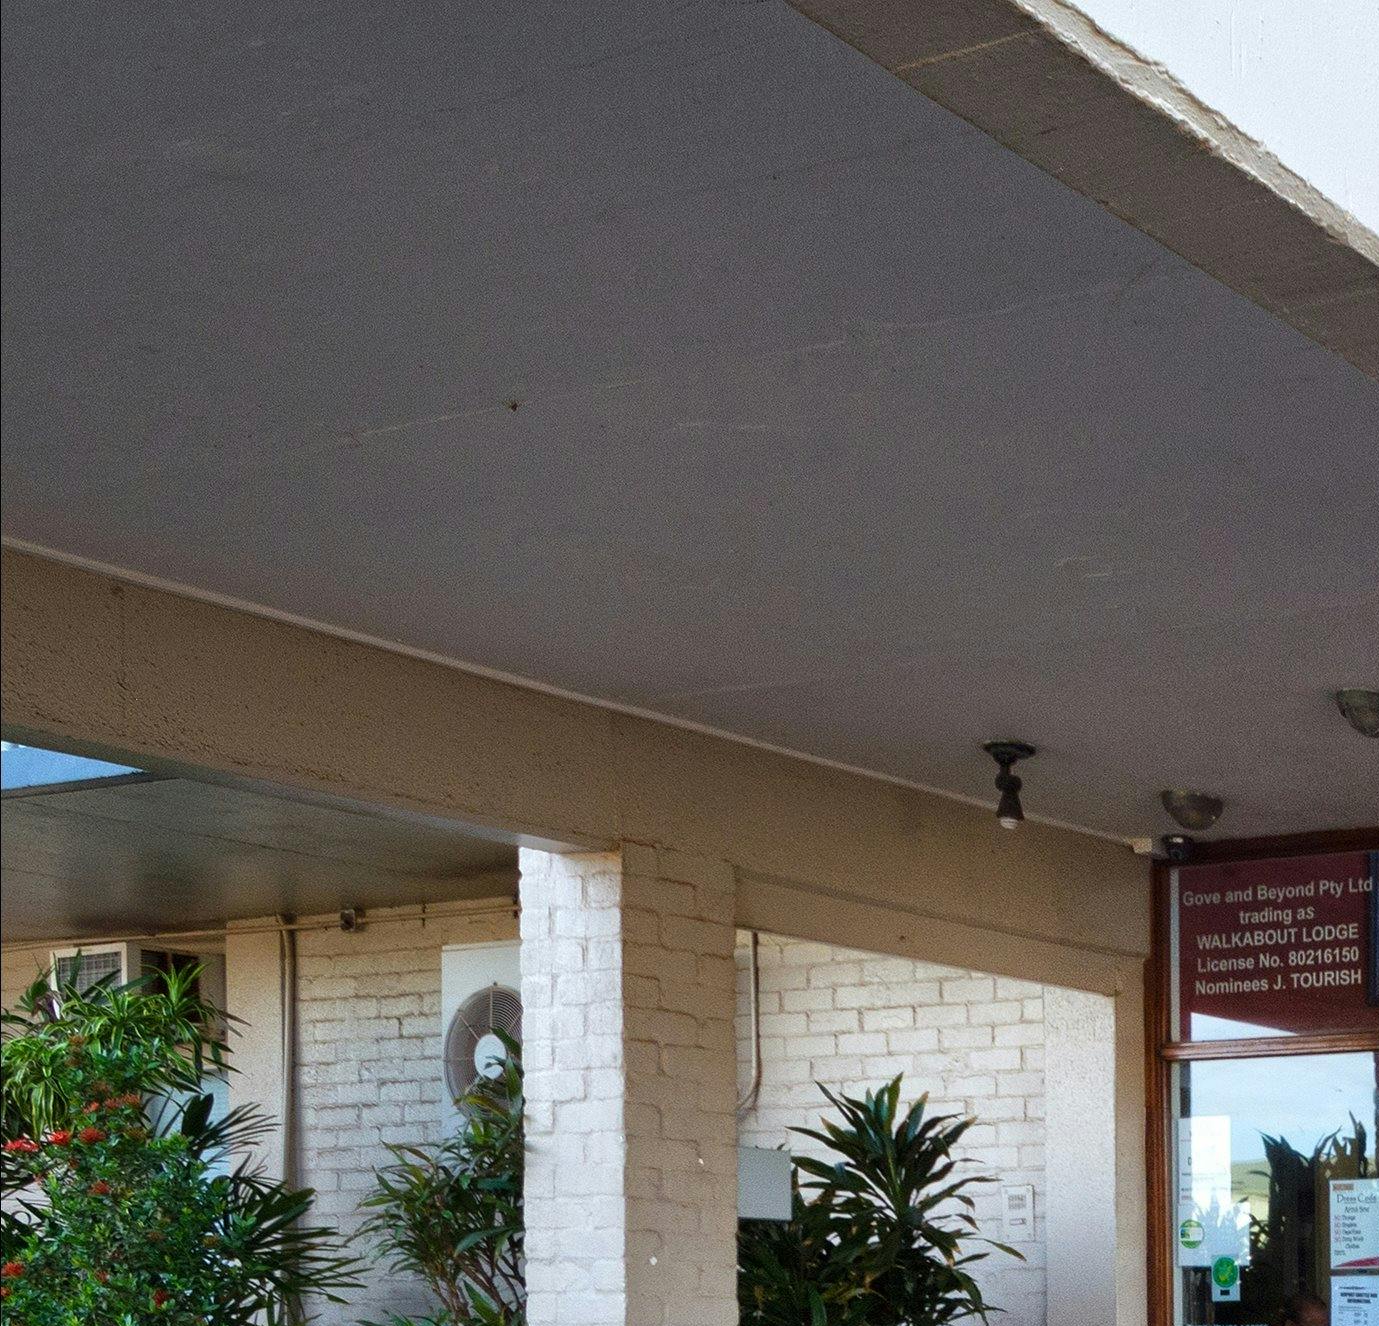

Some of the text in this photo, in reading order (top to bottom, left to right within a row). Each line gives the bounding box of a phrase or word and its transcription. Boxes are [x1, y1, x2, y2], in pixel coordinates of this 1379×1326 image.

[1182, 876, 1373, 906] Gove and Beyond Pty Ltd
[1239, 906, 1316, 925] trading as
[1196, 923, 1359, 950] WALKABOUT LODGE
[1197, 946, 1359, 973] License No. 80216150
[1195, 969, 1362, 995] Nominees J. TOURISH
